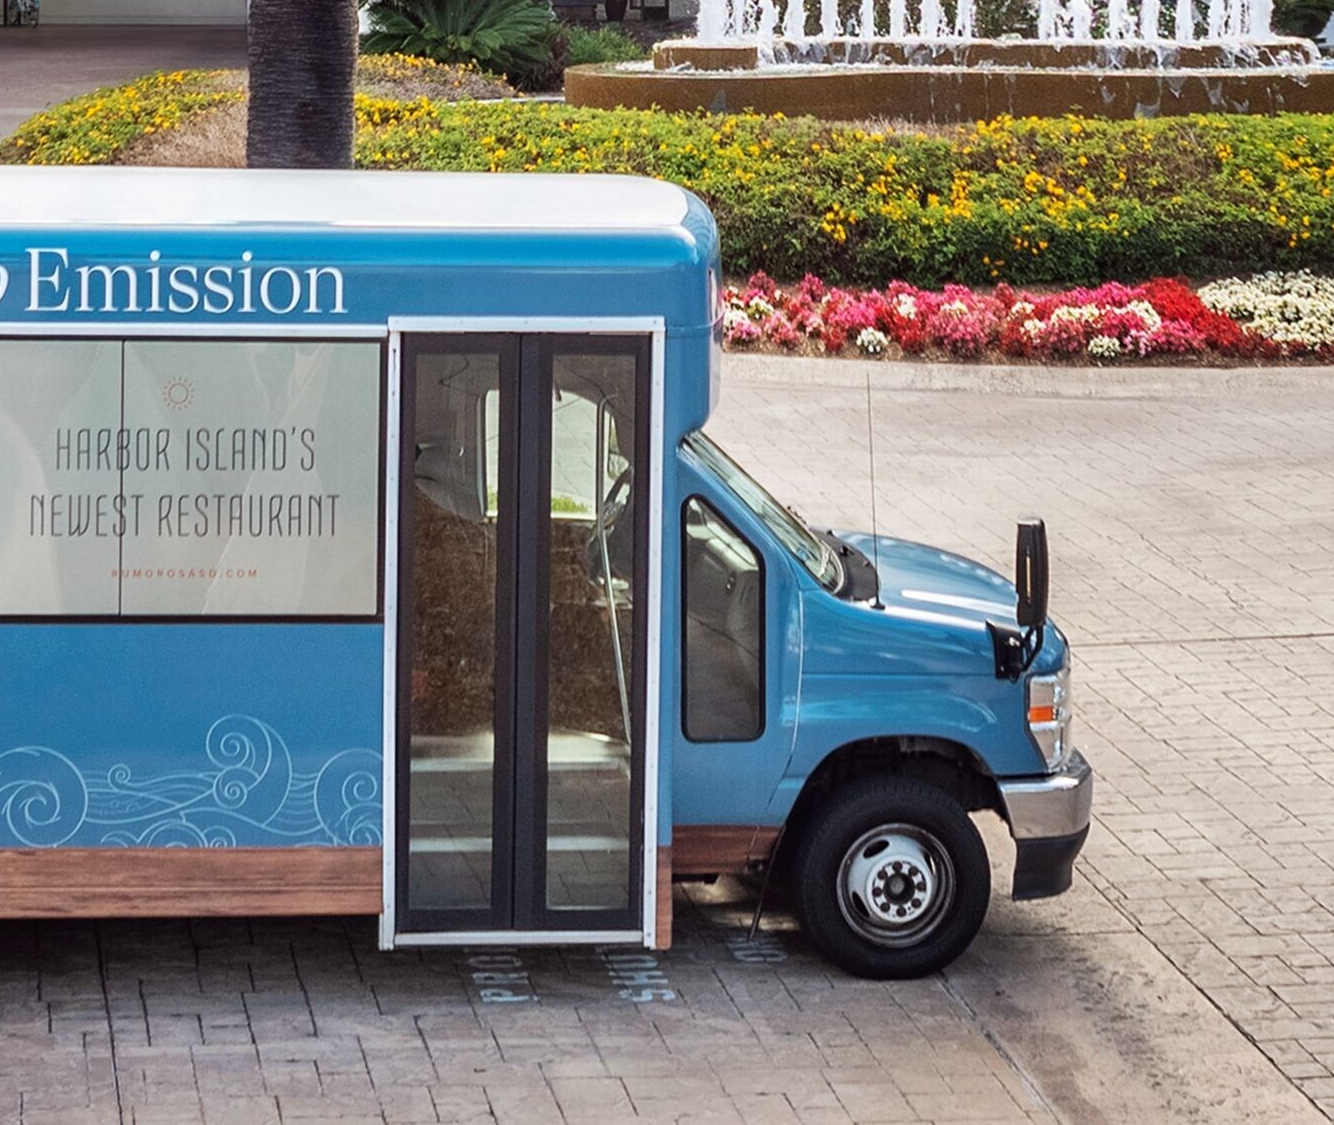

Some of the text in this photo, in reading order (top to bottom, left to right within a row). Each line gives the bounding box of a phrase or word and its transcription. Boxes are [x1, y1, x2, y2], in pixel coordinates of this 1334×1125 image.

[25, 247, 350, 314] Emission
[55, 426, 316, 472] HARBOR ISLAND'S
[29, 493, 341, 538] NEWEST RESTAURANT
